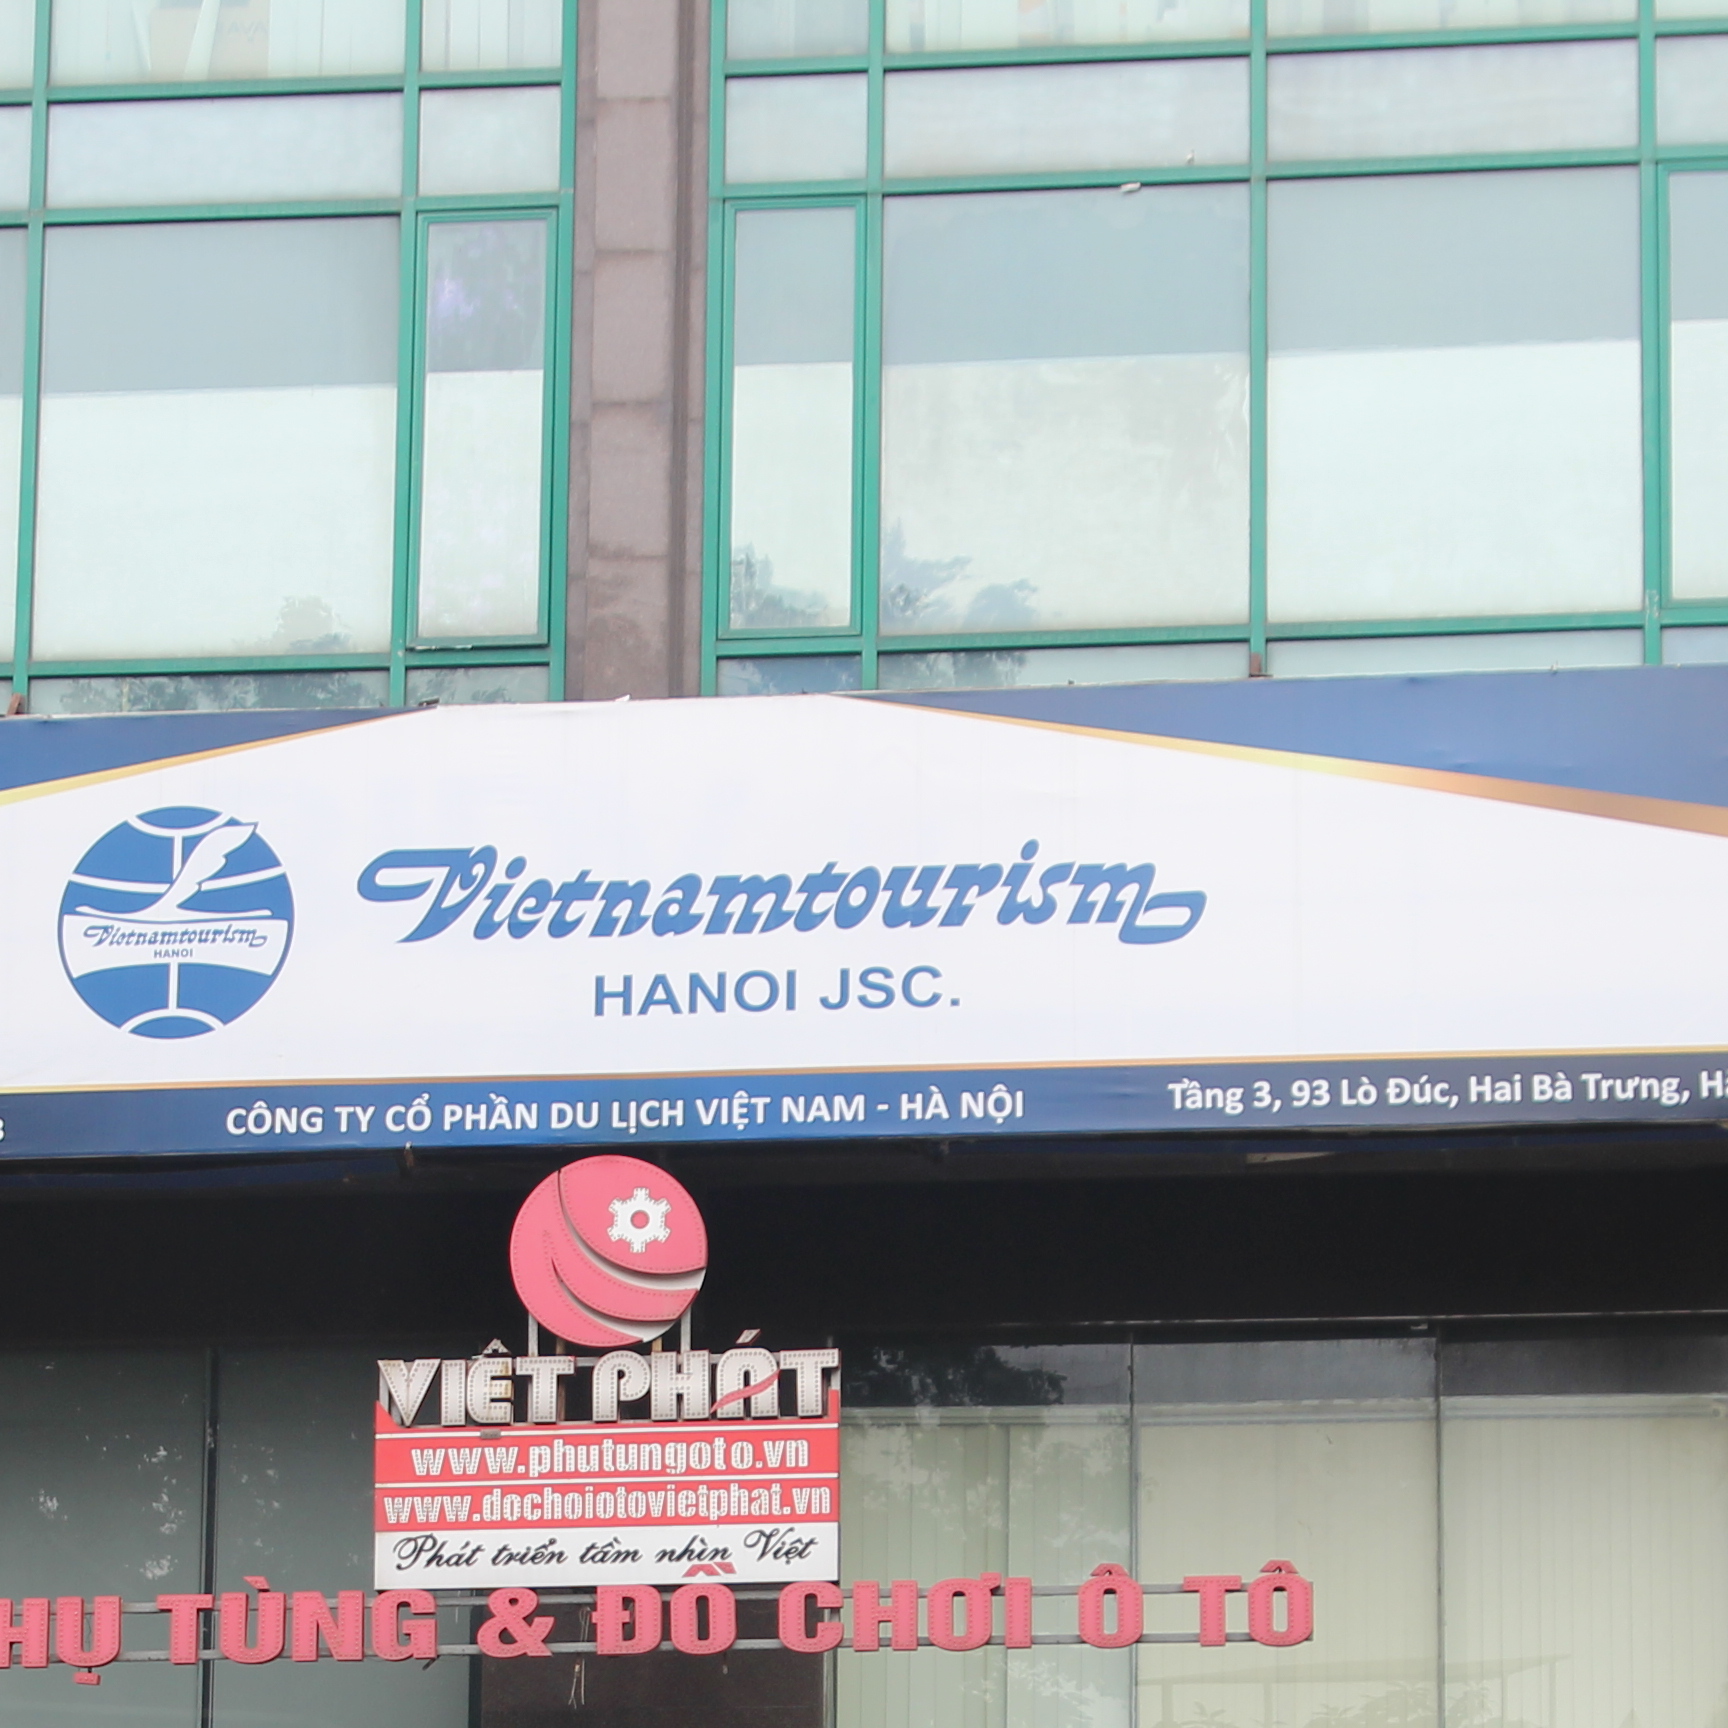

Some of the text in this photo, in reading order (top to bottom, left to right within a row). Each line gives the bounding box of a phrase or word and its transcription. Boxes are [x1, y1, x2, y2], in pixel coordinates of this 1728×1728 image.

[357, 839, 1206, 945] Vietnamtourism
[82, 921, 268, 948] Vietnamtourism
[153, 948, 194, 958] HANOI
[595, 965, 959, 1016] HANOI JSC.
[226, 1100, 324, 1135] CÔNG
[333, 1105, 376, 1133] TY
[384, 1092, 432, 1132] CỔ
[443, 1092, 538, 1131] PHẦN
[550, 1101, 599, 1129] DU
[611, 1099, 684, 1134] LỊCH
[695, 1090, 772, 1131] VIỆT
[781, 1094, 865, 1124] NAM
[900, 1085, 950, 1121] HÀ
[960, 1083, 1024, 1125] NỘI
[1166, 1077, 1245, 1115] Tầng
[1252, 1080, 1282, 1113] 3,
[1290, 1078, 1331, 1108] 93
[1340, 1076, 1378, 1106] Lò
[1384, 1074, 1459, 1109] Đúc,
[1468, 1073, 1522, 1103] Hai
[1531, 1071, 1573, 1102] Bà
[1579, 1072, 1691, 1106] Trưng,
[592, 1329, 839, 1422] PHÁT
[411, 1437, 809, 1478] www.phutungoto.vn
[384, 1483, 831, 1523] www.dochoiotovietphat.vn
[393, 1535, 480, 1570] Phát
[491, 1540, 567, 1566] triển
[578, 1538, 643, 1564] tầm
[744, 1529, 819, 1564] Việt
[156, 1575, 438, 1665] TÙNG
[476, 1587, 555, 1658] &
[591, 1561, 738, 1656] ĐỒ
[776, 1572, 1033, 1654] CHƠI
[1077, 1563, 1143, 1648] Ô
[1182, 1560, 1313, 1647] TÔ
